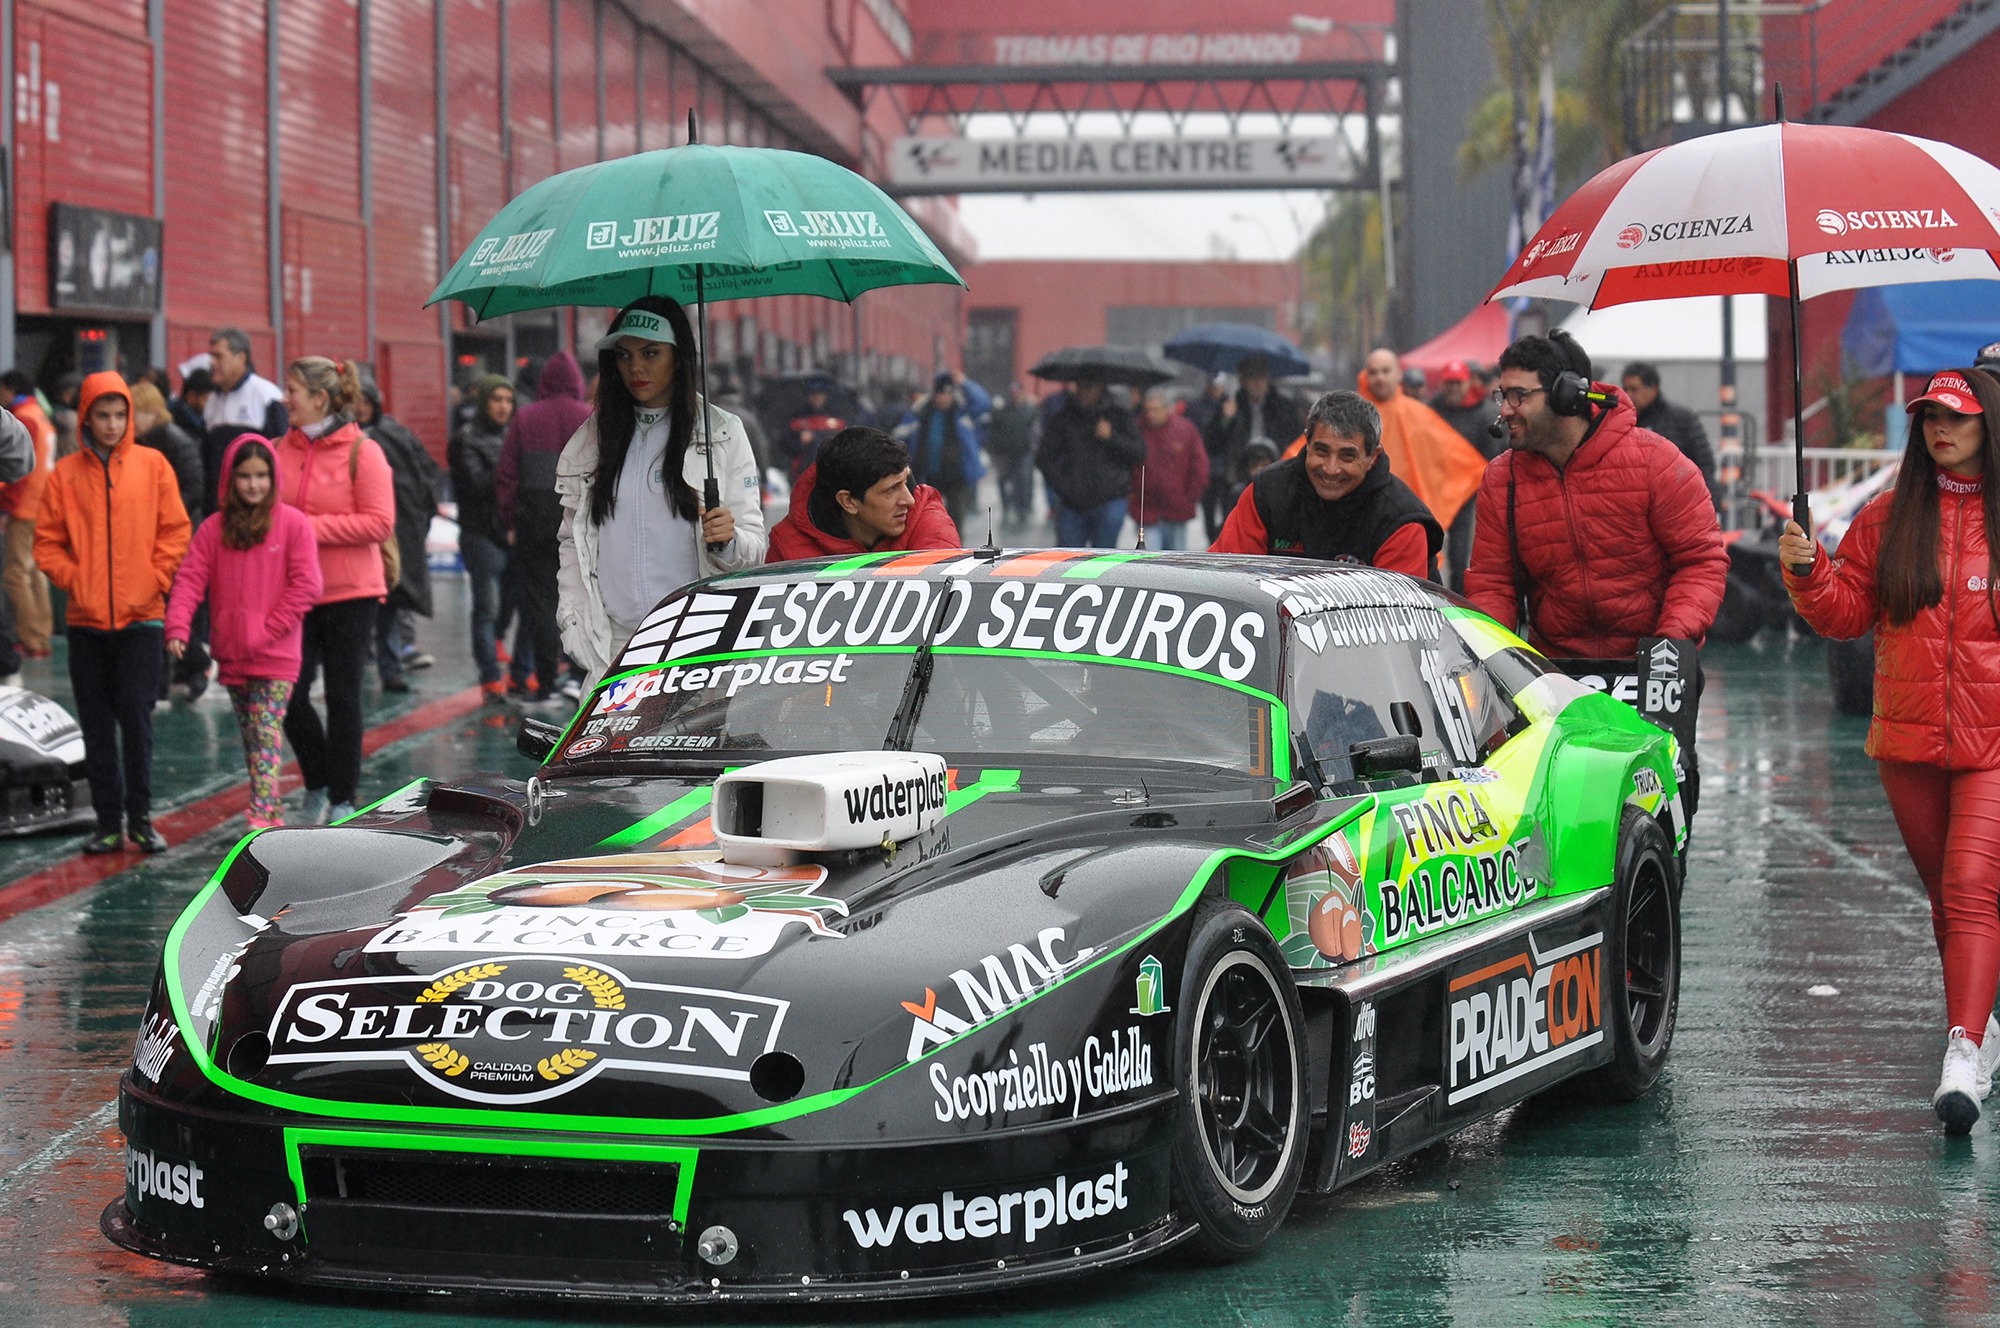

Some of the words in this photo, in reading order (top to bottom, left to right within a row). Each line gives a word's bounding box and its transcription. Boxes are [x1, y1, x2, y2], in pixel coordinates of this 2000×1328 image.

[994, 36, 1107, 65] TERMAS
[1111, 35, 1147, 65] DE
[1150, 35, 1199, 64] RIO
[1202, 34, 1301, 64] HONDO
[980, 143, 1098, 173] MEDIA
[1110, 142, 1254, 172] CENTRE
[620, 211, 720, 247] JELUZ
[798, 210, 887, 238] JELUZ
[1648, 213, 1754, 243] SCIENZA
[1847, 208, 1958, 230] SCIENZA
[489, 228, 556, 263] JELUZ
[618, 239, 717, 258] www.jeluz.net
[806, 238, 891, 249] www.jeluz.net
[480, 258, 536, 276] www.jeluz.net
[621, 314, 660, 331] JELUZ
[733, 580, 972, 651] ESCUDO
[977, 581, 1265, 682] SEGUROS
[600, 653, 853, 709] waterplast
[1645, 680, 1682, 713] BC
[581, 717, 613, 736] TCP
[614, 716, 641, 732] 115
[628, 736, 717, 748] CRISTEM
[844, 762, 947, 831] waterplast
[1633, 770, 1659, 796] TRUCK
[1391, 790, 1499, 861] FINCA
[481, 913, 678, 929] FINCA
[381, 929, 751, 953] BALCARCE
[948, 927, 1094, 1021] MAC
[463, 981, 585, 1003] DOG
[286, 993, 759, 1057] SELECTION
[1450, 948, 1600, 1088] PRADECON
[470, 1072, 534, 1083] PREMIUM
[473, 1062, 532, 1073] CALIDAD
[929, 1042, 1068, 1122] Scorziello
[1067, 1055, 1081, 1119] y
[1084, 1025, 1153, 1097] Galella
[1350, 1075, 1375, 1107] BC
[843, 1161, 1128, 1249] waterplast
